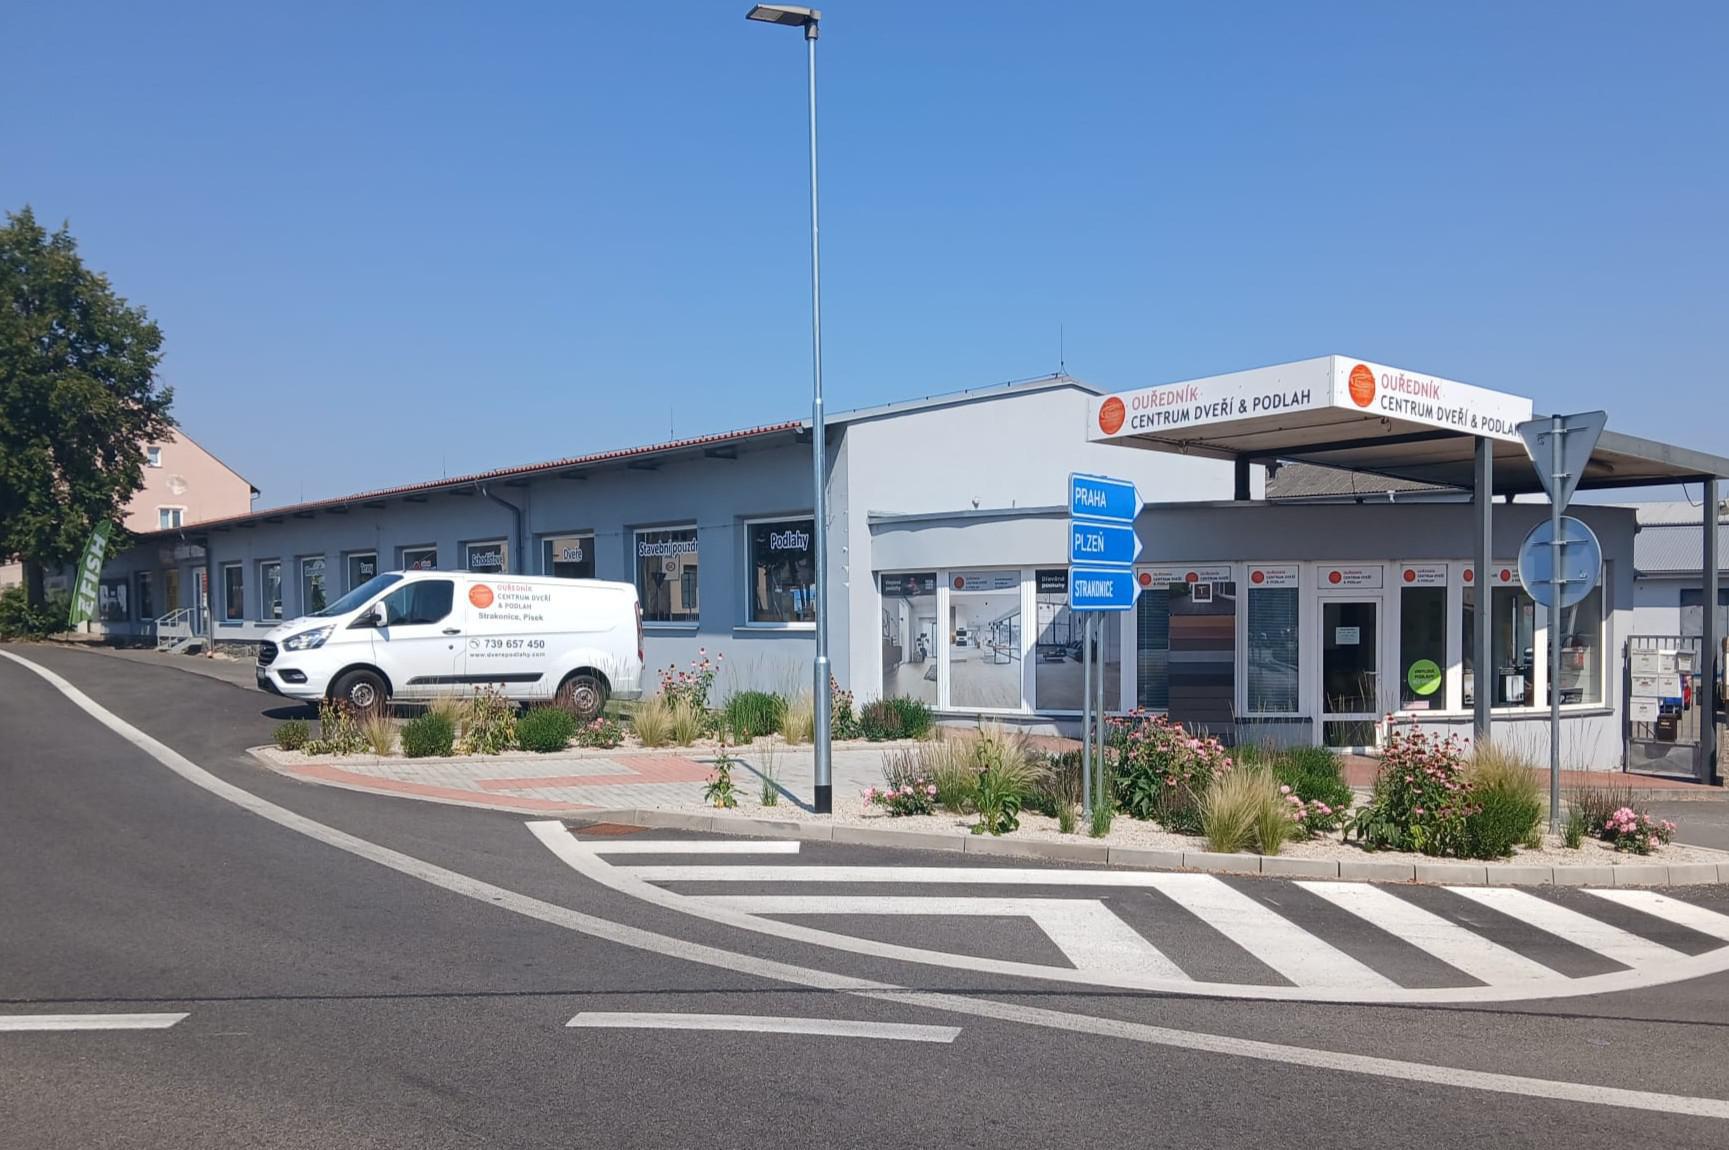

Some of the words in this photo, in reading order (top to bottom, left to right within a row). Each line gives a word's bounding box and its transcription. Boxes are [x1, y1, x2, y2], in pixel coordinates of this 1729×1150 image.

[1381, 373, 1440, 400] OUŘEDNÍK
[1132, 384, 1199, 411] OUŘEDNÍK
[1131, 408, 1190, 429] CENTRUM
[1194, 397, 1234, 420] DVEŘÍ
[1238, 399, 1248, 413] &
[1253, 389, 1311, 411] PODLAH
[1380, 395, 1433, 420] CENTRUM
[1437, 406, 1469, 427] DVEŘÍ
[1471, 414, 1478, 429] &
[1075, 487, 1107, 508] PRAHA
[639, 539, 671, 557] Stavební
[770, 530, 809, 550] Podlahy
[1075, 531, 1105, 553] PLZEŇ
[1075, 580, 1114, 598] STRAKONICE
[478, 612, 521, 621] Strakonice,
[484, 639, 503, 649] 739
[506, 639, 524, 649] 657
[527, 639, 545, 649] 450
